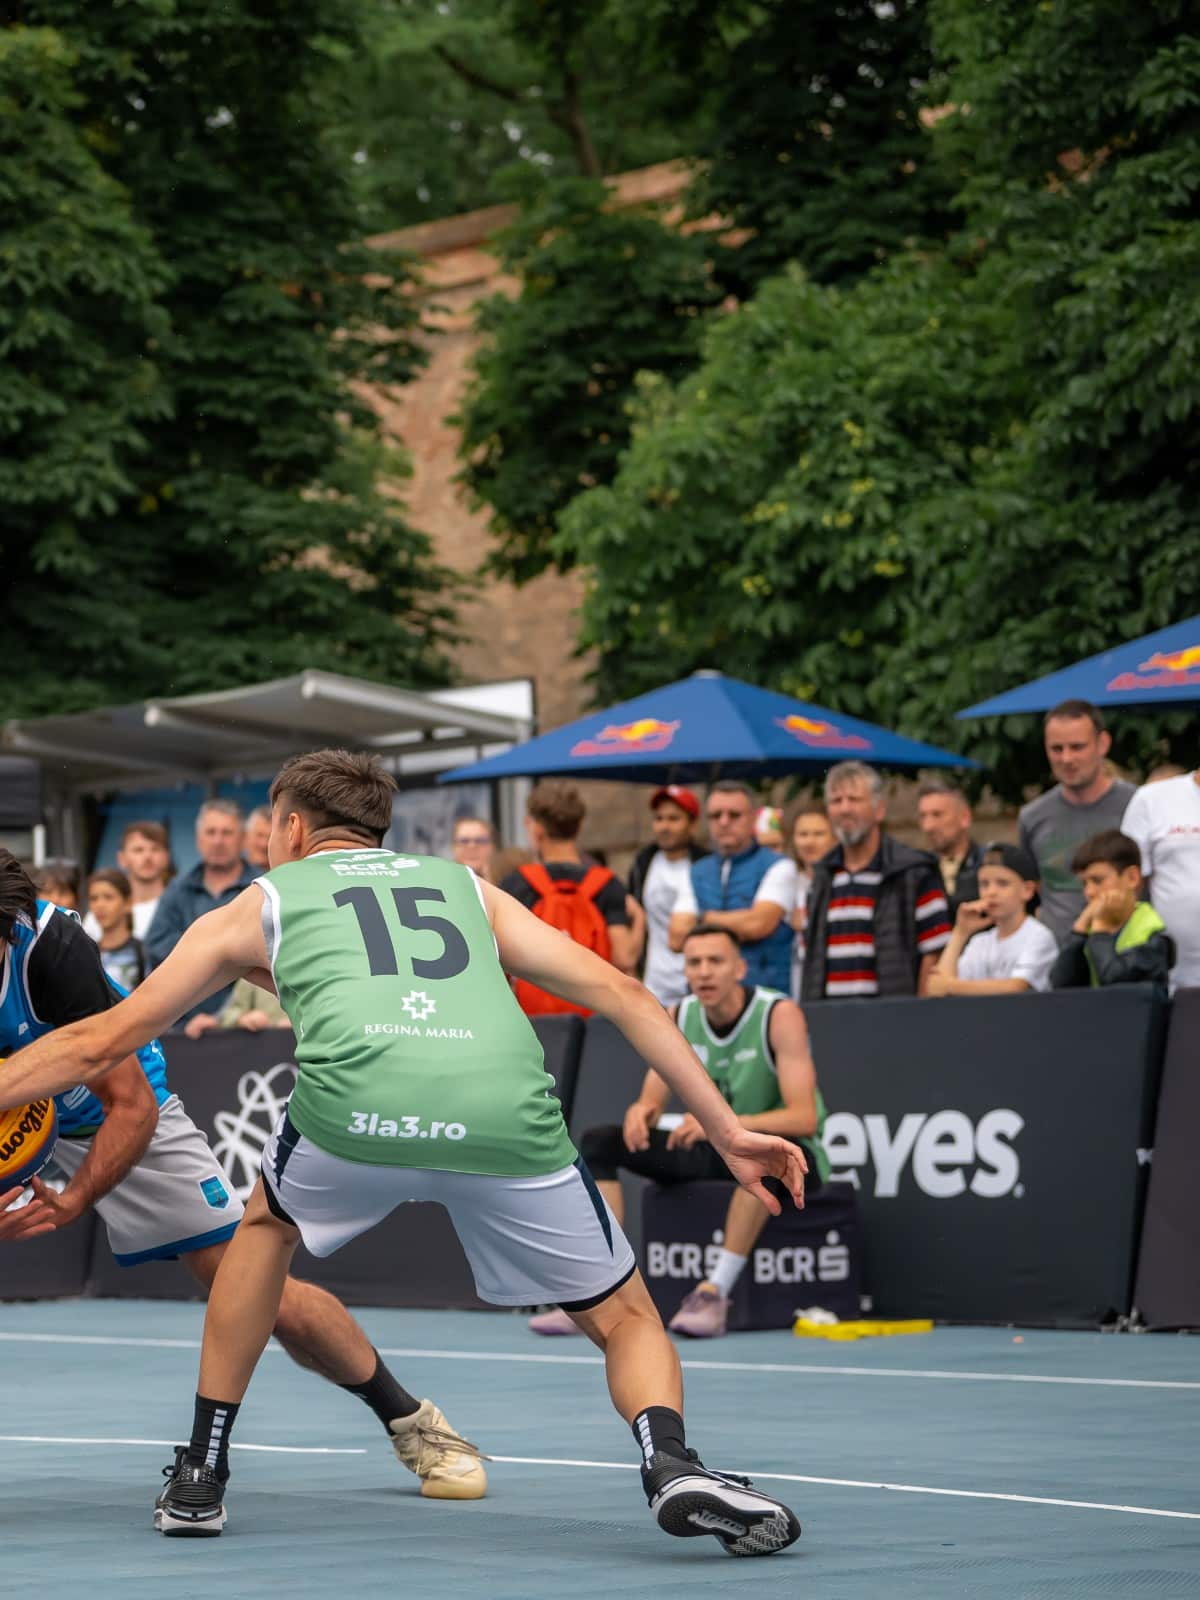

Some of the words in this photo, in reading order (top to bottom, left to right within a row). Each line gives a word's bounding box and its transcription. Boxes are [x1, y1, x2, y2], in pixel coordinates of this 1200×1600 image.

[332, 886, 471, 980] 15
[364, 1023, 421, 1036] REGINA
[425, 1028, 474, 1040] MARIA
[347, 1111, 467, 1141] 3la3.ro
[822, 1109, 1025, 1199] eyes
[647, 1242, 701, 1278] BCR
[754, 1248, 816, 1284] BCR
